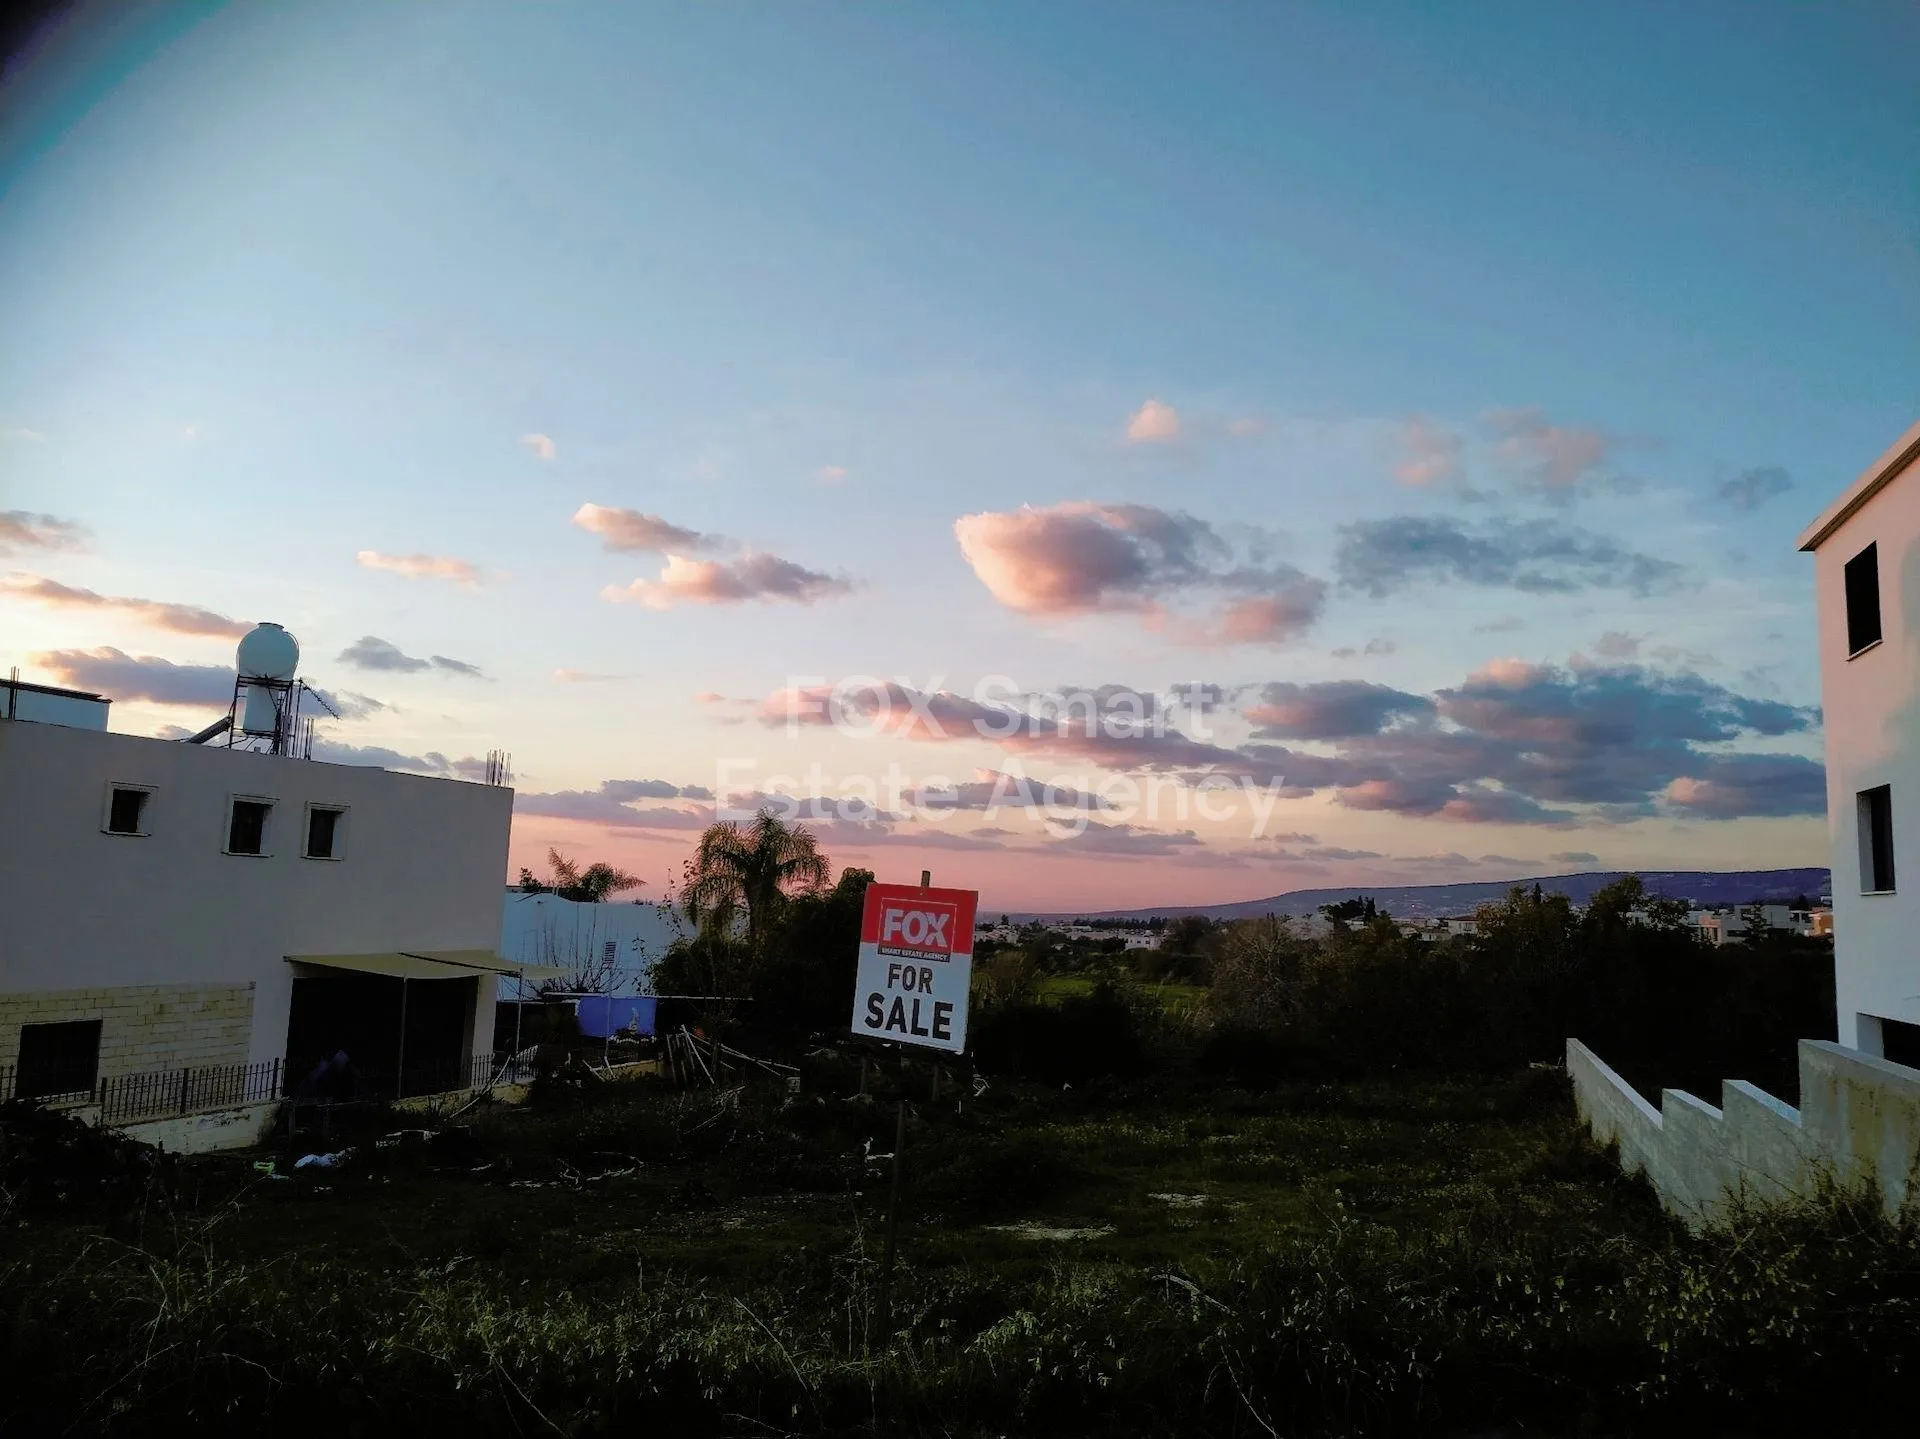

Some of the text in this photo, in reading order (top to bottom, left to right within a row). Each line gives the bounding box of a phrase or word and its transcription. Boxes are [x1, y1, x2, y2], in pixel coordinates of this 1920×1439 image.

[883, 908, 949, 947] FOX
[923, 952, 948, 961] AGENCY
[888, 963, 933, 994] FOR
[865, 992, 953, 1040] SALE
